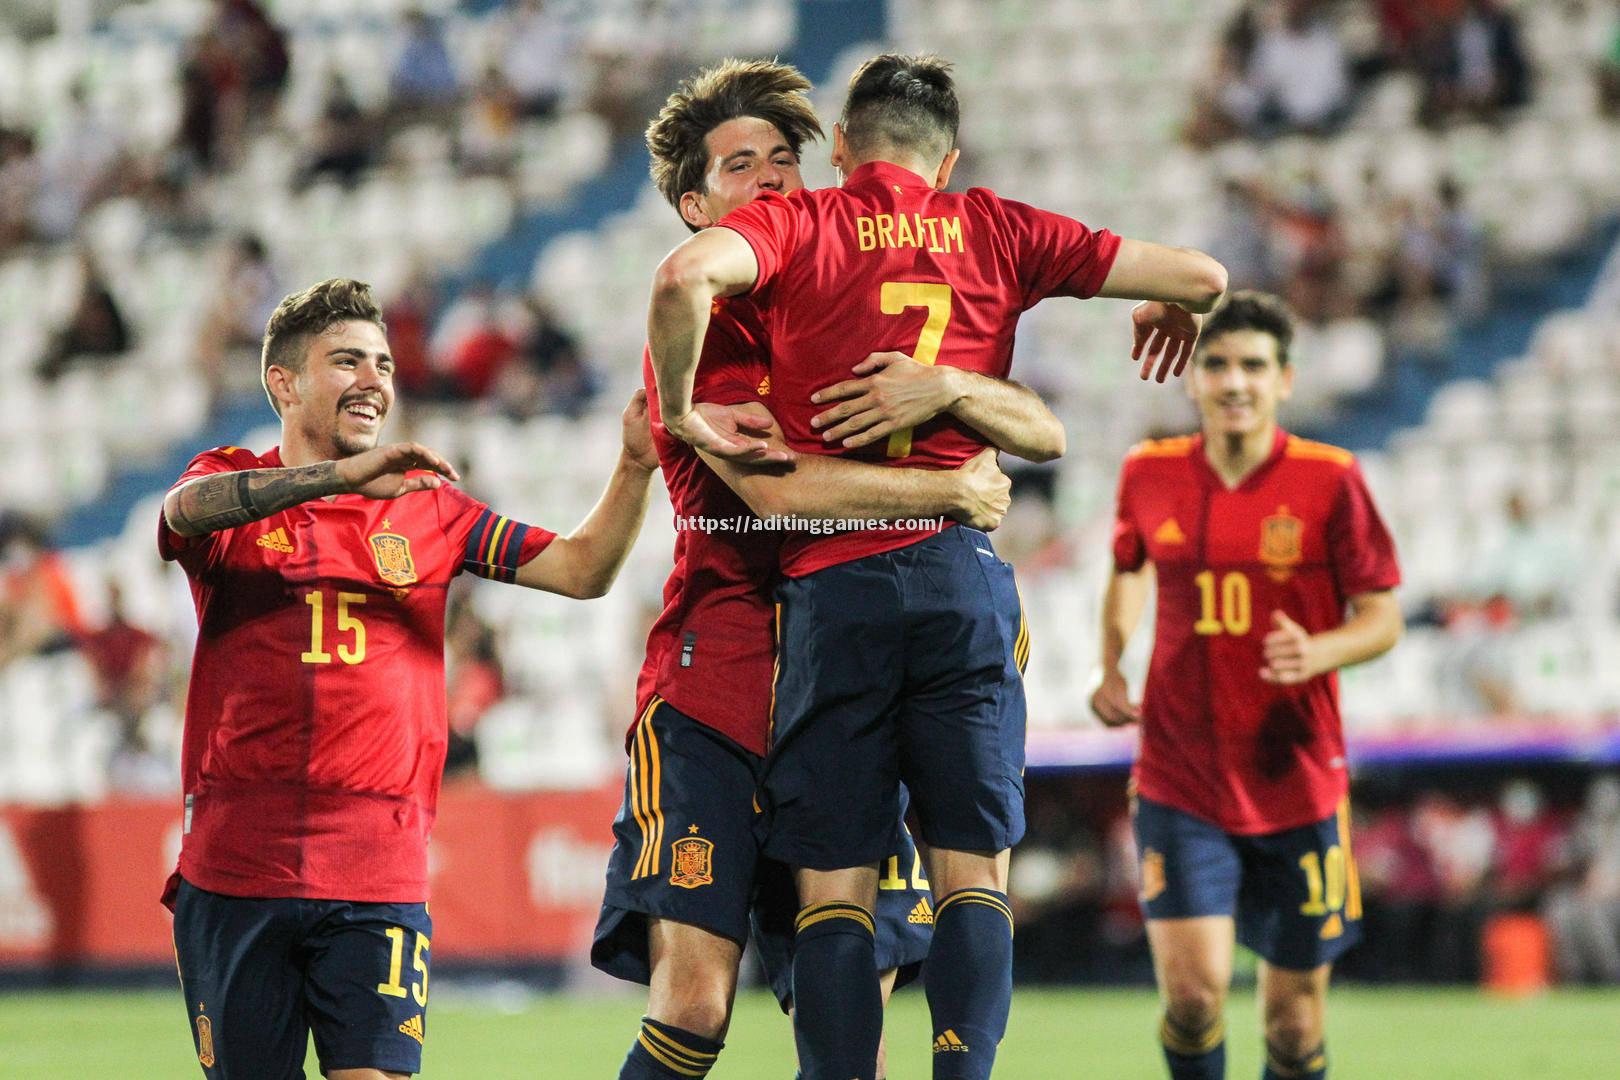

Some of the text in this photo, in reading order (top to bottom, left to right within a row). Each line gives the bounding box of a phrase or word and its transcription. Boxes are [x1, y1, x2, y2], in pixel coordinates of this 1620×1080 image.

[880, 281, 952, 458] 7
[256, 538, 294, 554] adidas
[301, 590, 367, 665] 15
[1193, 571, 1251, 636] 10
[1299, 845, 1346, 916] 10
[907, 914, 934, 924] adida
[377, 927, 431, 1008] 15
